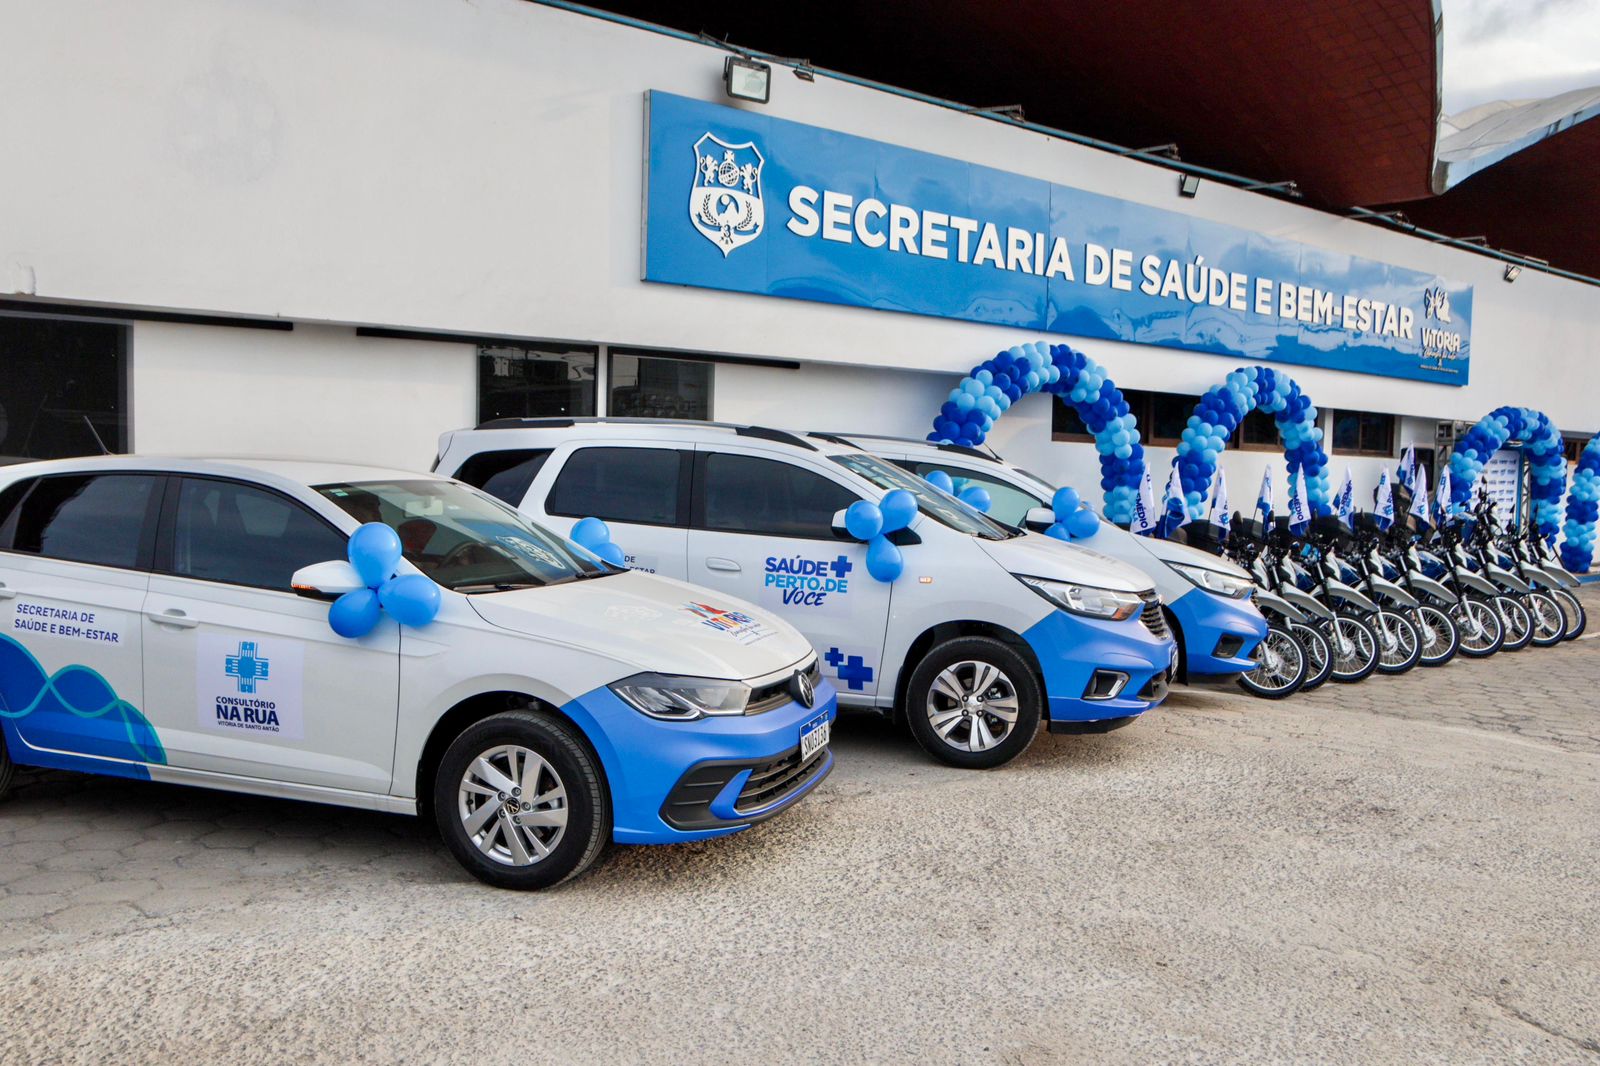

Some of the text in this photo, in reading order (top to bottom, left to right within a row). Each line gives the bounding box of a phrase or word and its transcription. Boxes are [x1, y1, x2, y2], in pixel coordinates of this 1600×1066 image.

[787, 185, 1414, 339] SECRETARIA DE SAÚDE E BEM-ESTAR
[624, 555, 636, 563] DE
[765, 555, 828, 577] SAÚDE
[765, 573, 848, 593] PERTO DE
[783, 586, 827, 606] VOCÊ
[16, 603, 95, 624] SECRETARIA DE
[14, 617, 119, 643] SAÚDE E BEM-ESTAR
[216, 696, 276, 709] CONSULTÓRIO
[216, 704, 280, 726] NA RUA
